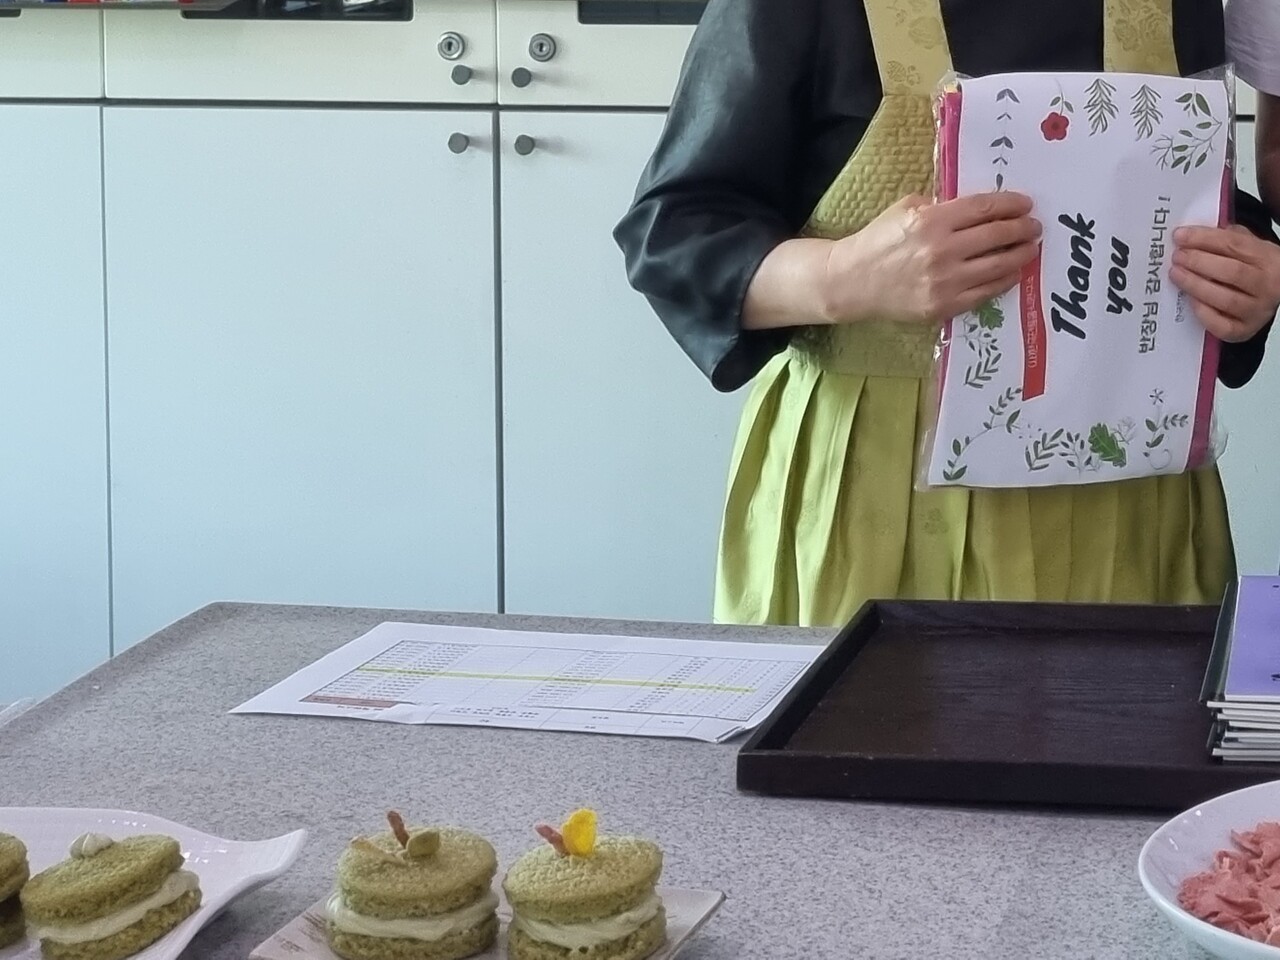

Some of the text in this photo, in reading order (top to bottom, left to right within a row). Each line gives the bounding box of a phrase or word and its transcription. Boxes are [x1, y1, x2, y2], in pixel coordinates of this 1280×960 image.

[1050, 212, 1096, 340] Thank
[1106, 236, 1133, 315] you
[1138, 301, 1159, 353] 반장님
